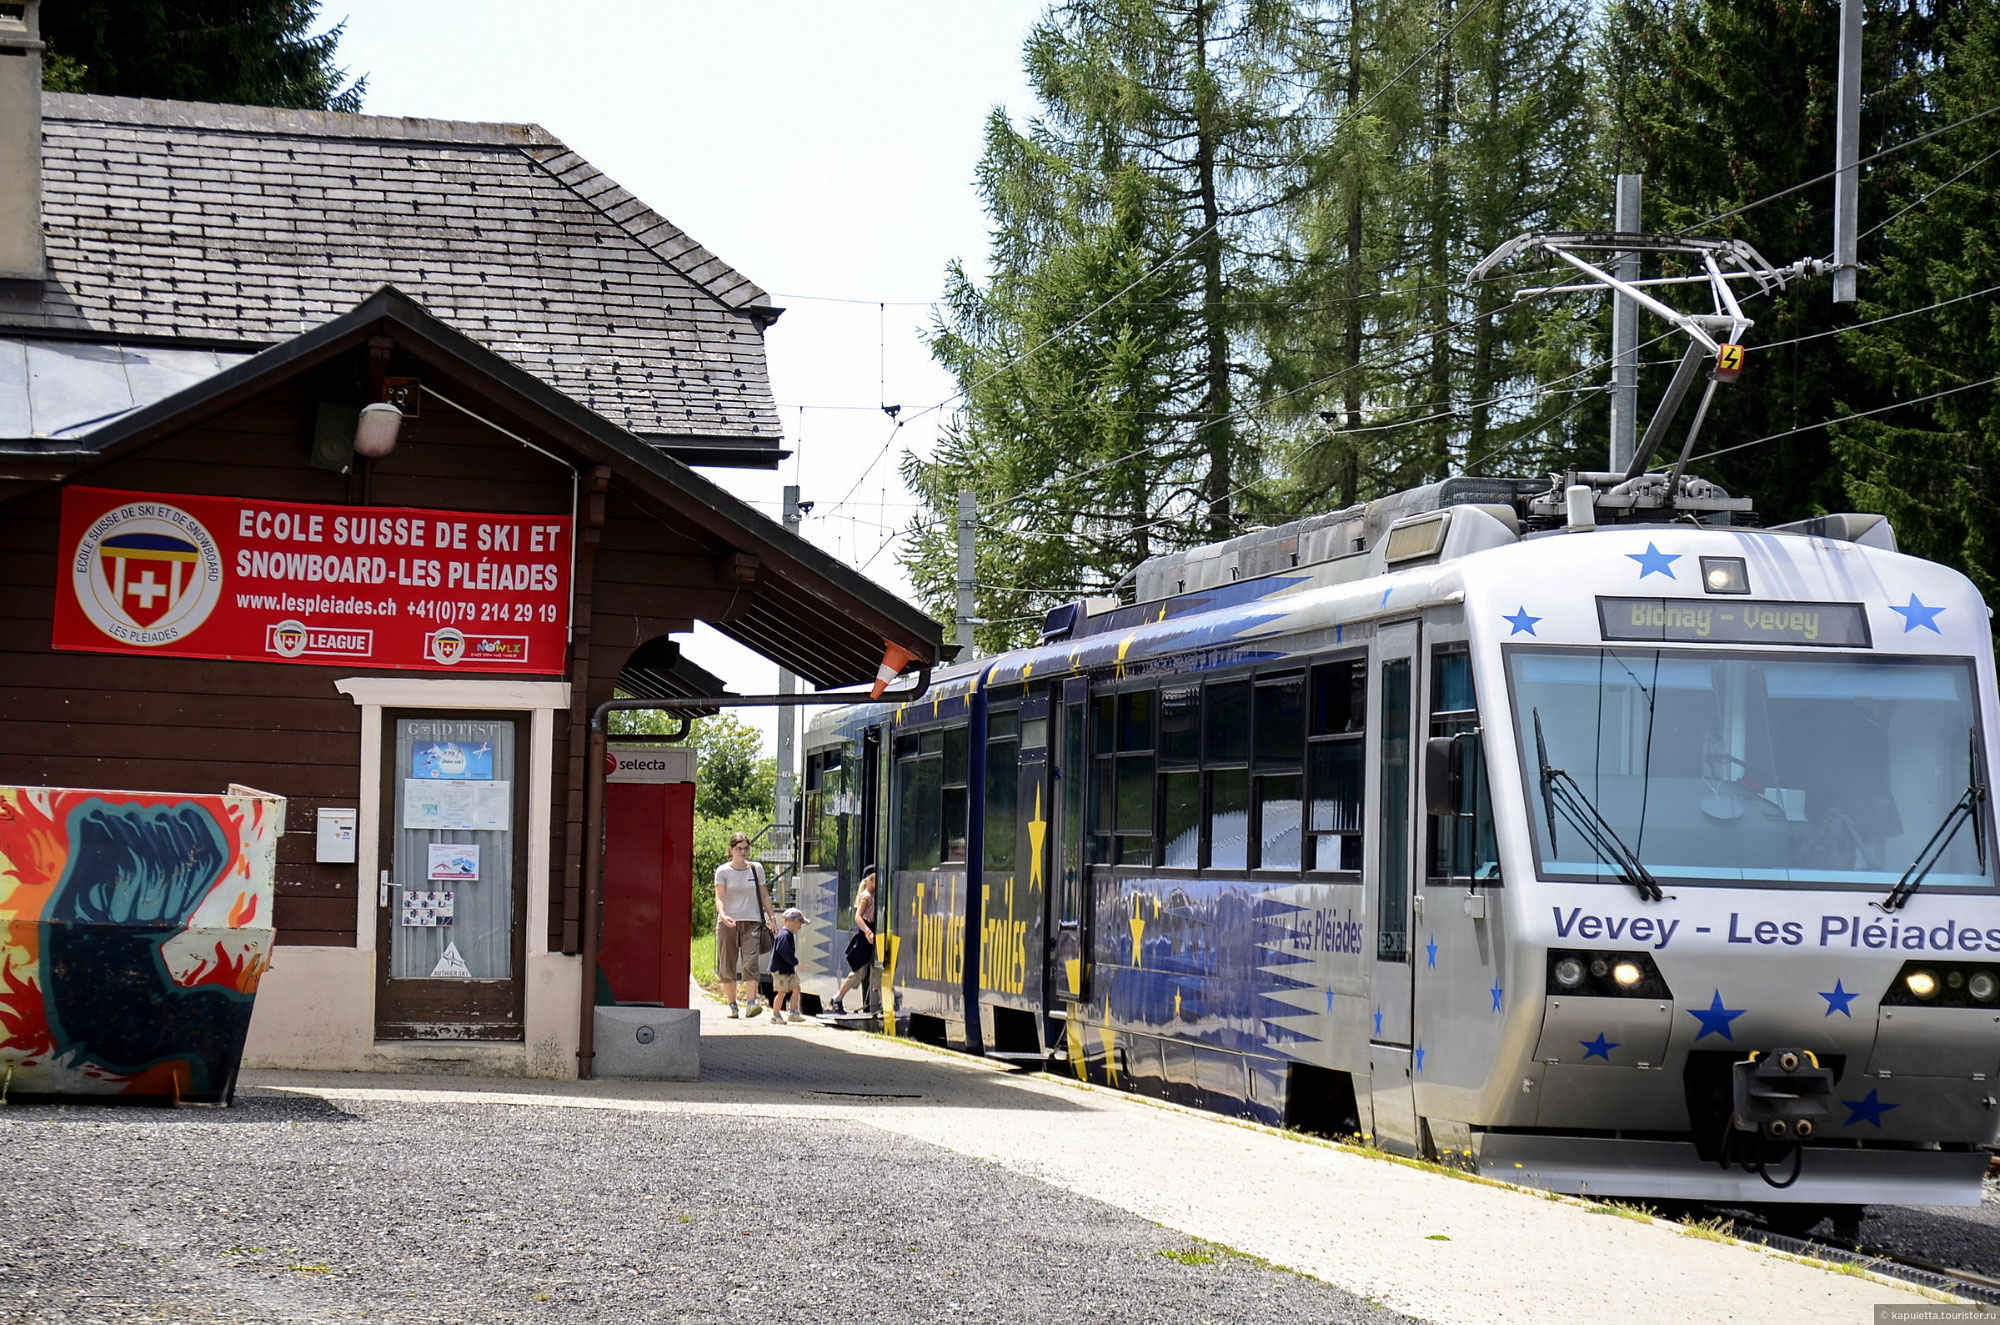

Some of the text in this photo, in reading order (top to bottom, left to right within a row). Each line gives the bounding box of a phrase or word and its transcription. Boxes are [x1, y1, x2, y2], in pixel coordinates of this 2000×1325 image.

[76, 505, 218, 582] ECOLE SUISSE DE SKI ET DE SNOWBOARD
[239, 509, 560, 552] ECOLE SUISSE DE SKI ET
[448, 556, 558, 591] PLÉIADES
[236, 592, 557, 624] www.lespleiades.ch +41(0)79 214 29 19
[1631, 603, 1713, 636] Blonay
[1743, 607, 1820, 640] Vevey
[108, 622, 178, 643] LES PLÉIADES
[309, 634, 366, 650] LEAGUE
[620, 759, 666, 770] selecta
[1294, 911, 1312, 952] Les
[1315, 908, 1363, 954] Pléiades
[1552, 906, 1680, 950] Vevey
[1728, 912, 1804, 946] Les
[1820, 915, 2000, 952] Pléiades
